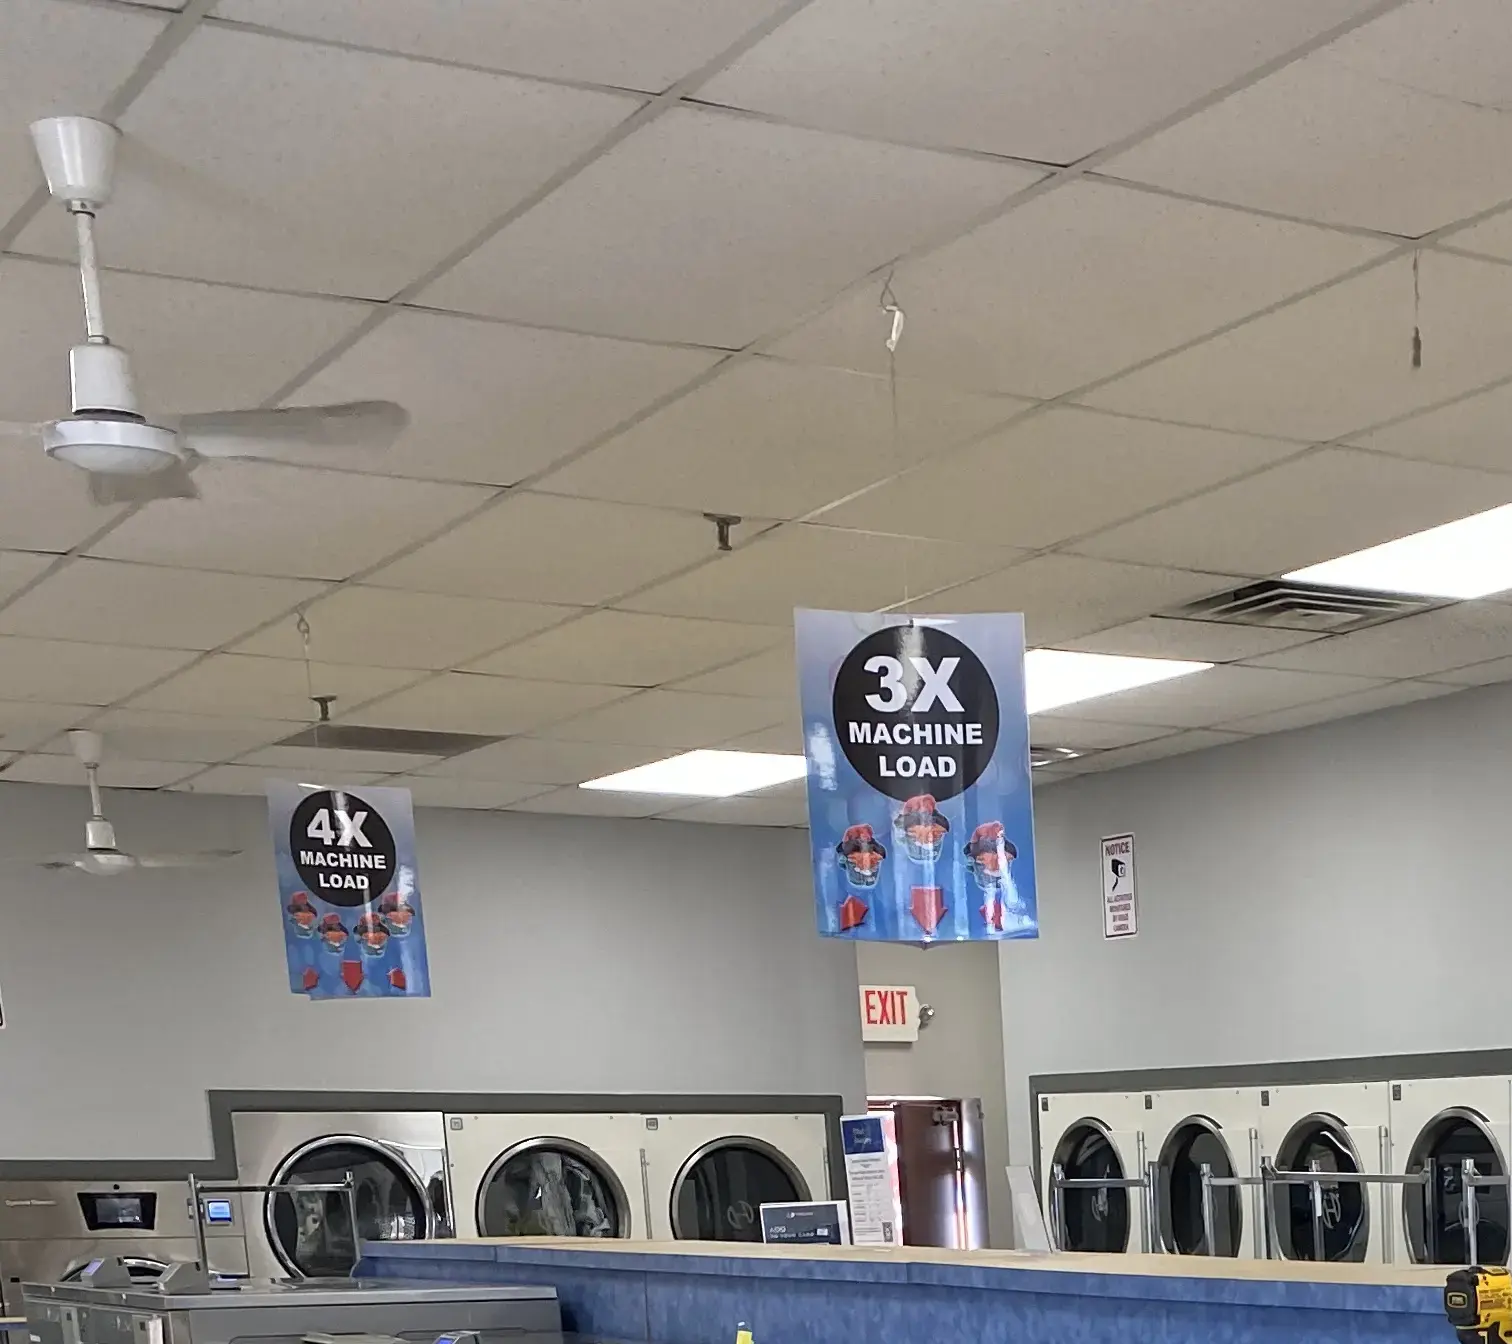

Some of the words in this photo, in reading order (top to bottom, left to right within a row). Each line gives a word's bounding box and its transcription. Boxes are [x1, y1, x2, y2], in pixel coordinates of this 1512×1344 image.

[863, 655, 966, 714] 3X
[848, 721, 983, 746] MACHINE
[879, 754, 957, 779] LOAD
[307, 808, 373, 848] 4X
[300, 851, 387, 870] MACHINE
[1105, 841, 1131, 856] NOTICE
[319, 873, 369, 890] LOAD
[865, 990, 908, 1025] EXIT
